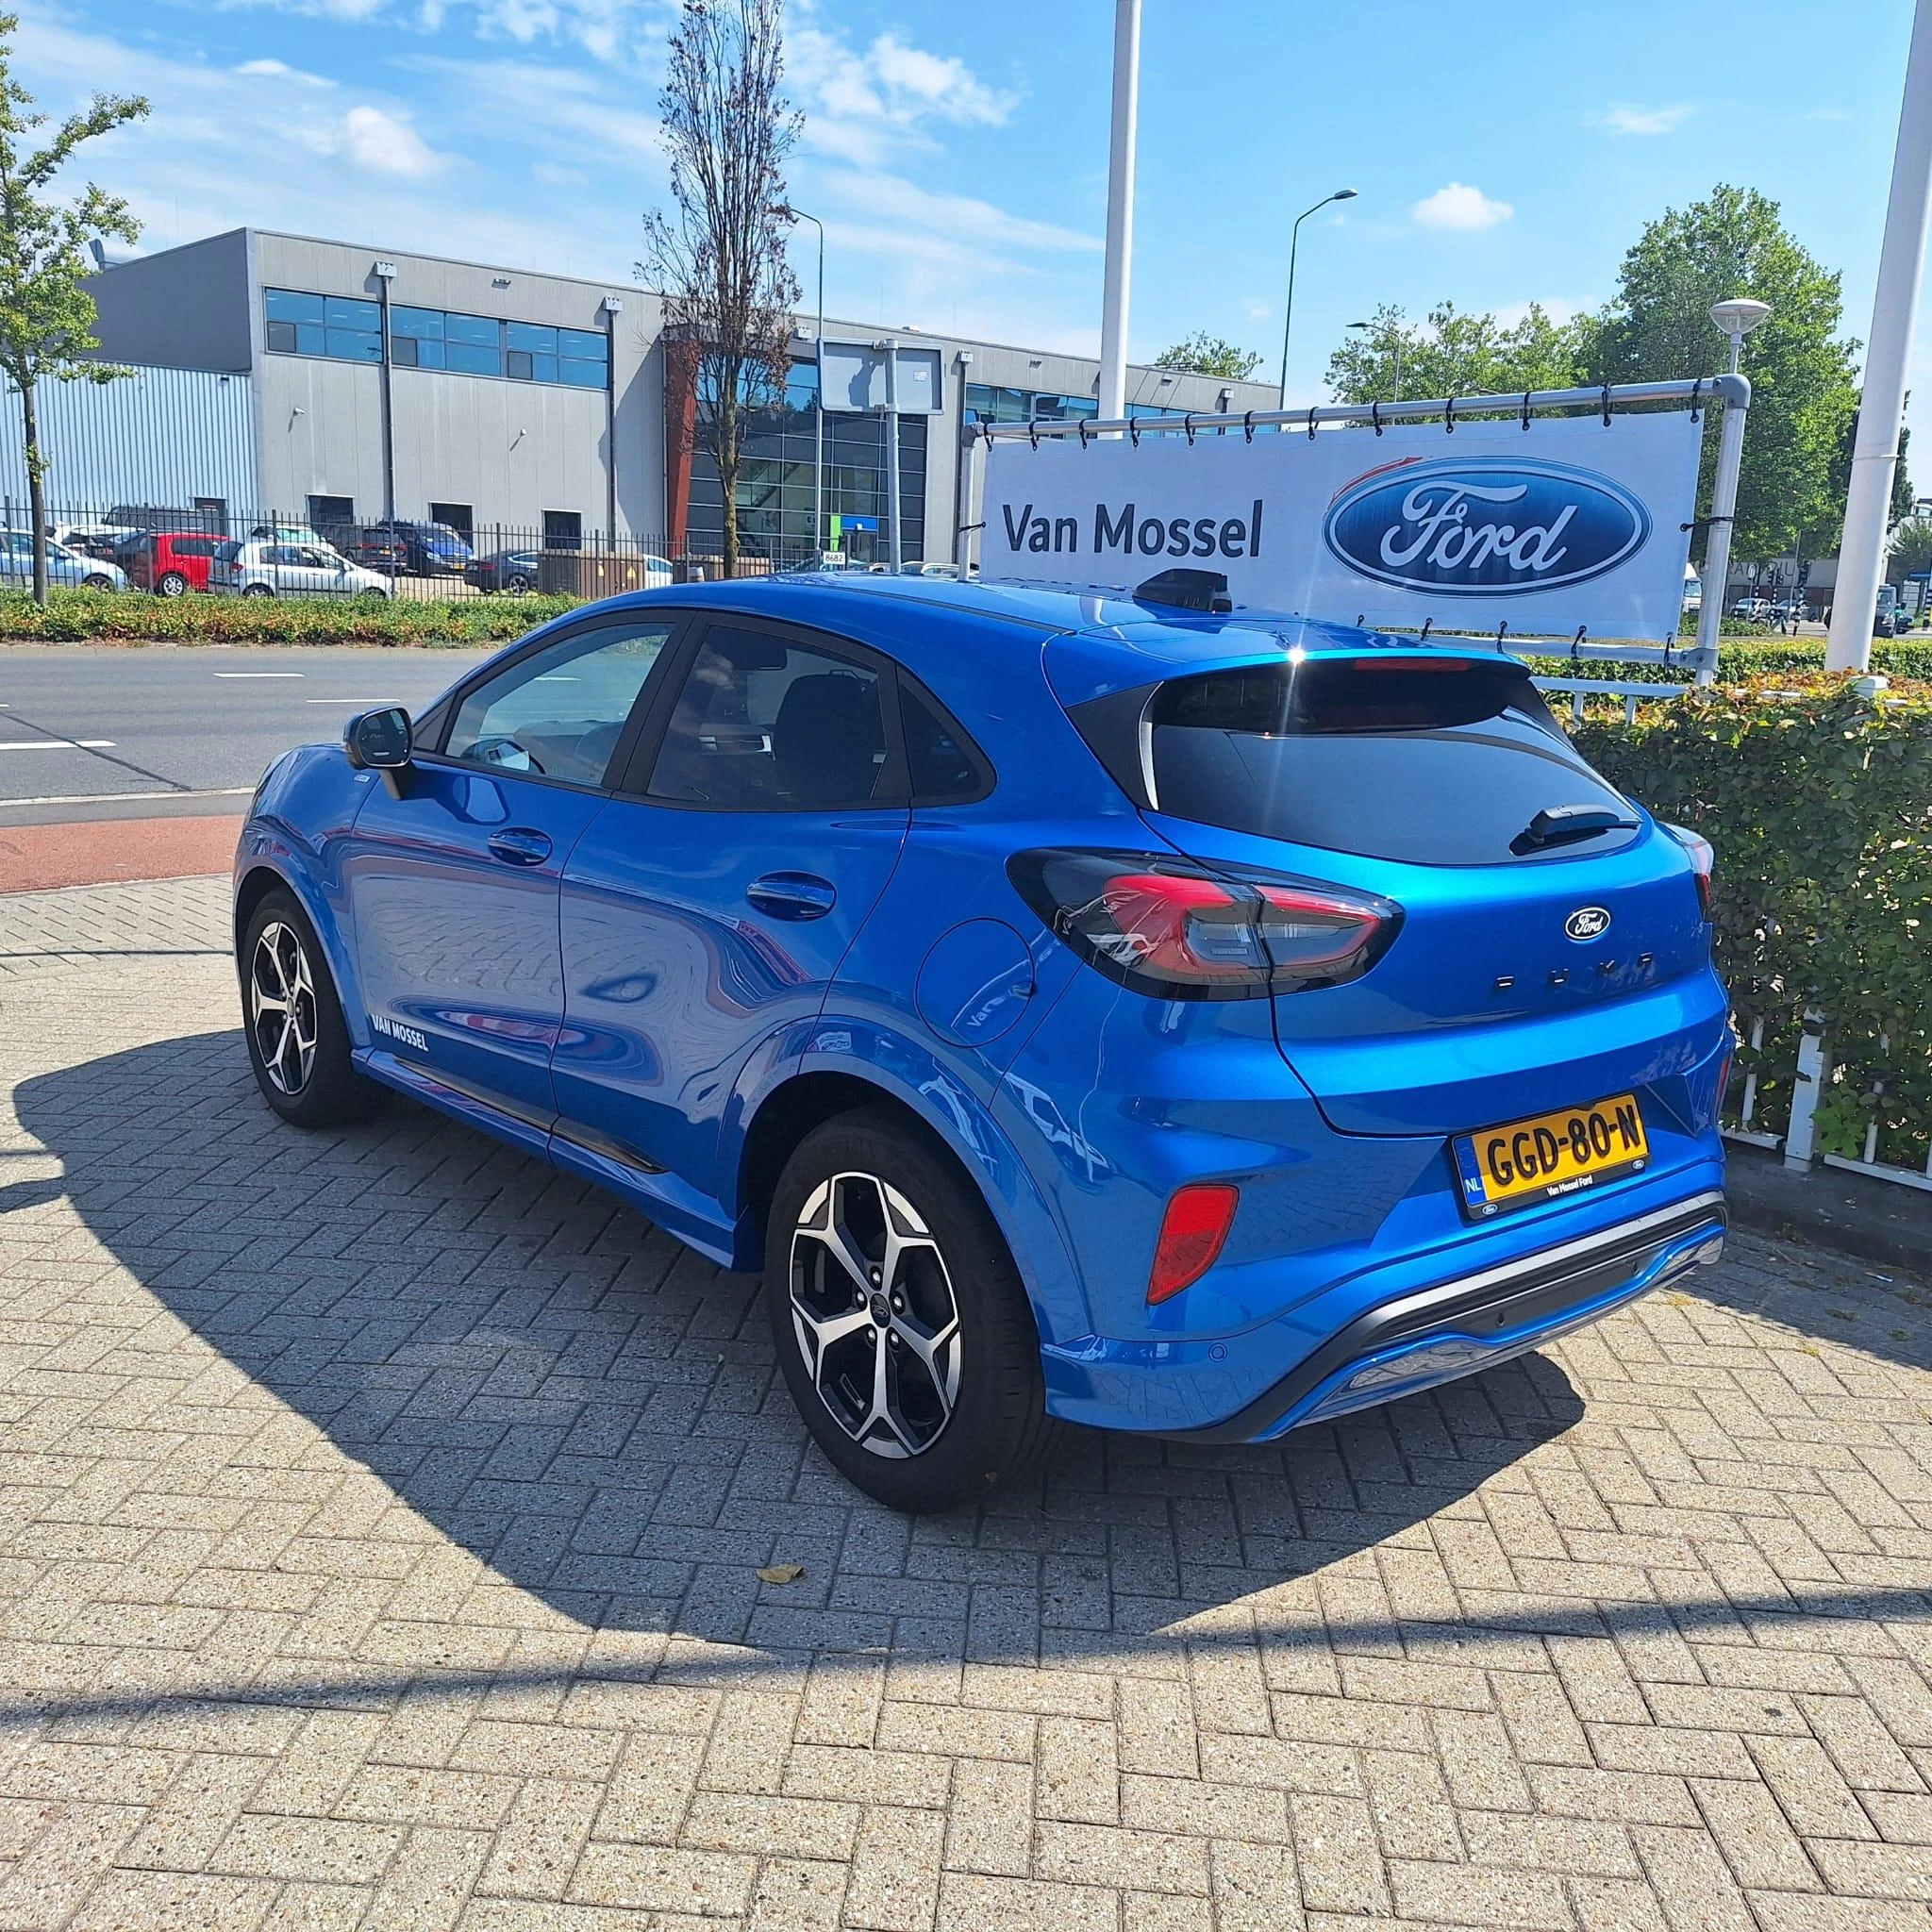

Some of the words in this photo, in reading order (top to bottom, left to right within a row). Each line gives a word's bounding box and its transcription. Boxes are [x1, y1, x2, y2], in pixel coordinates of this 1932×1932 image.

[1002, 504, 1077, 553] Van
[1093, 499, 1263, 558] Mossel
[1380, 480, 1578, 572] Ford
[1574, 912, 1604, 935] Ford
[372, 1013, 391, 1037] VAN
[391, 1021, 428, 1052] MOSSEL
[1487, 1104, 1641, 1187] GGD-80-N
[1465, 1177, 1483, 1193] NL
[1546, 1186, 1559, 1197] Van
[1558, 1178, 1579, 1193] Mossel
[1578, 1174, 1593, 1187] Ford
